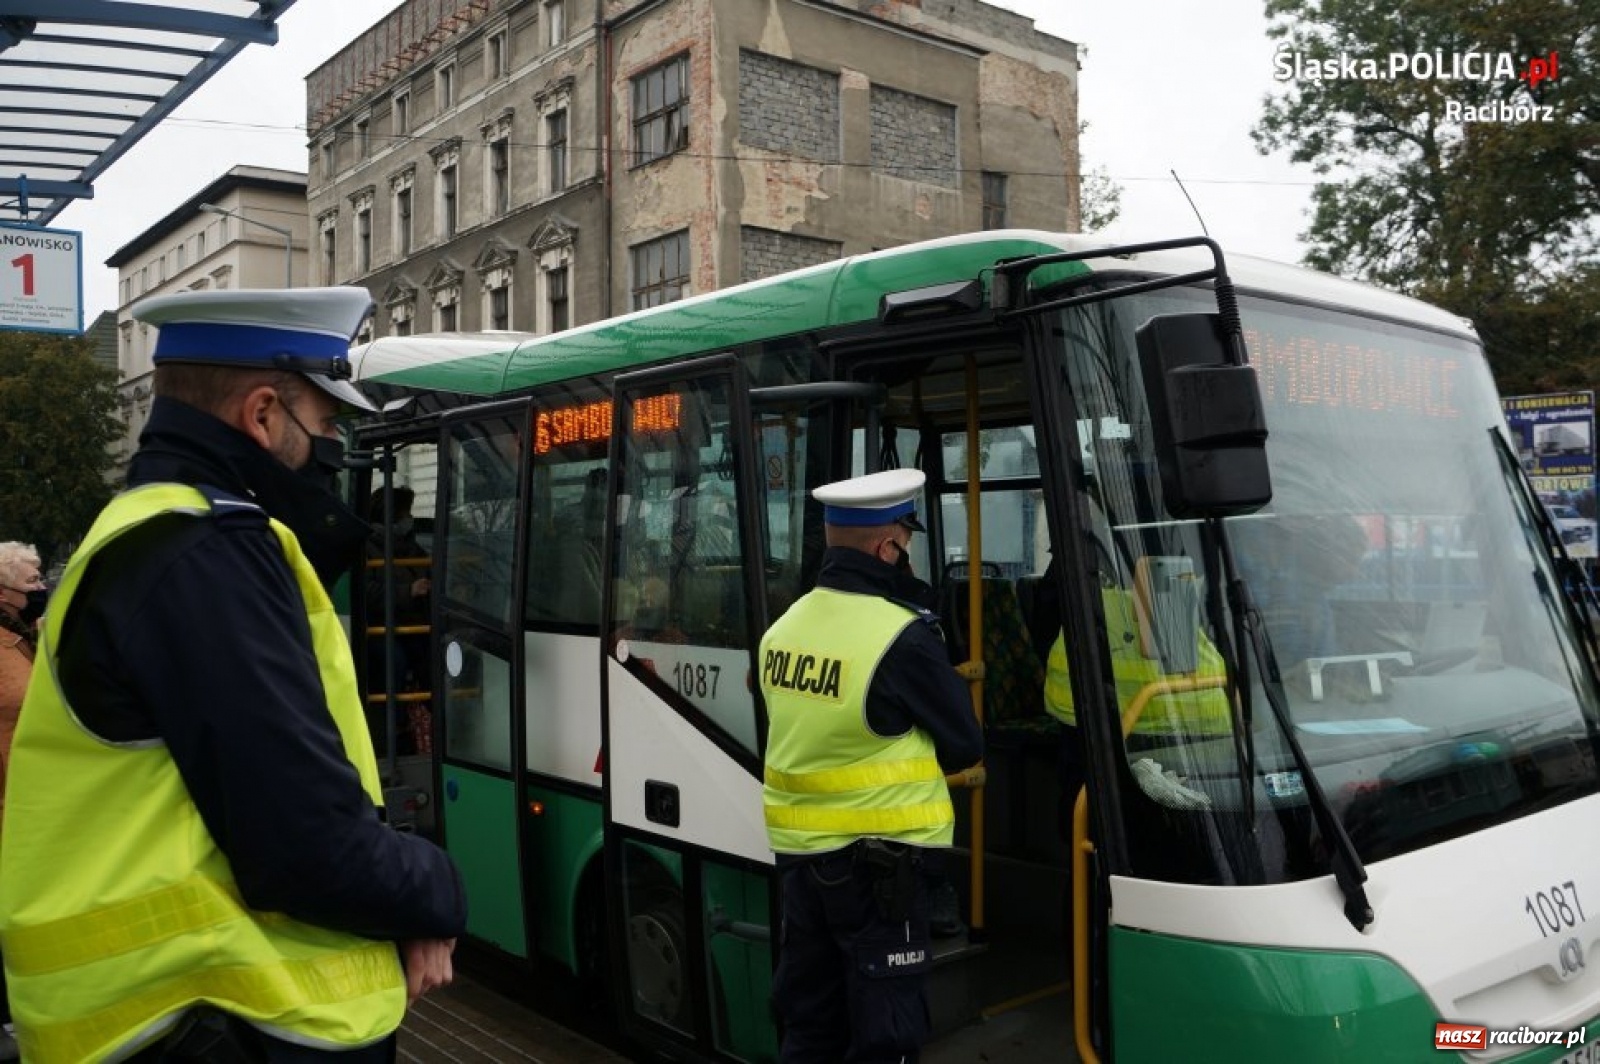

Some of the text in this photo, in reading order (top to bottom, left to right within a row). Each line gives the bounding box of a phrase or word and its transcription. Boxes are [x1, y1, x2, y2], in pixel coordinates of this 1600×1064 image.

[0, 235, 73, 251] NOWISKO
[11, 253, 34, 296] 1
[1533, 478, 1590, 491] ORTOWE
[673, 661, 721, 699] 1087
[764, 650, 841, 698] POLICJA
[1525, 880, 1586, 938] 1087
